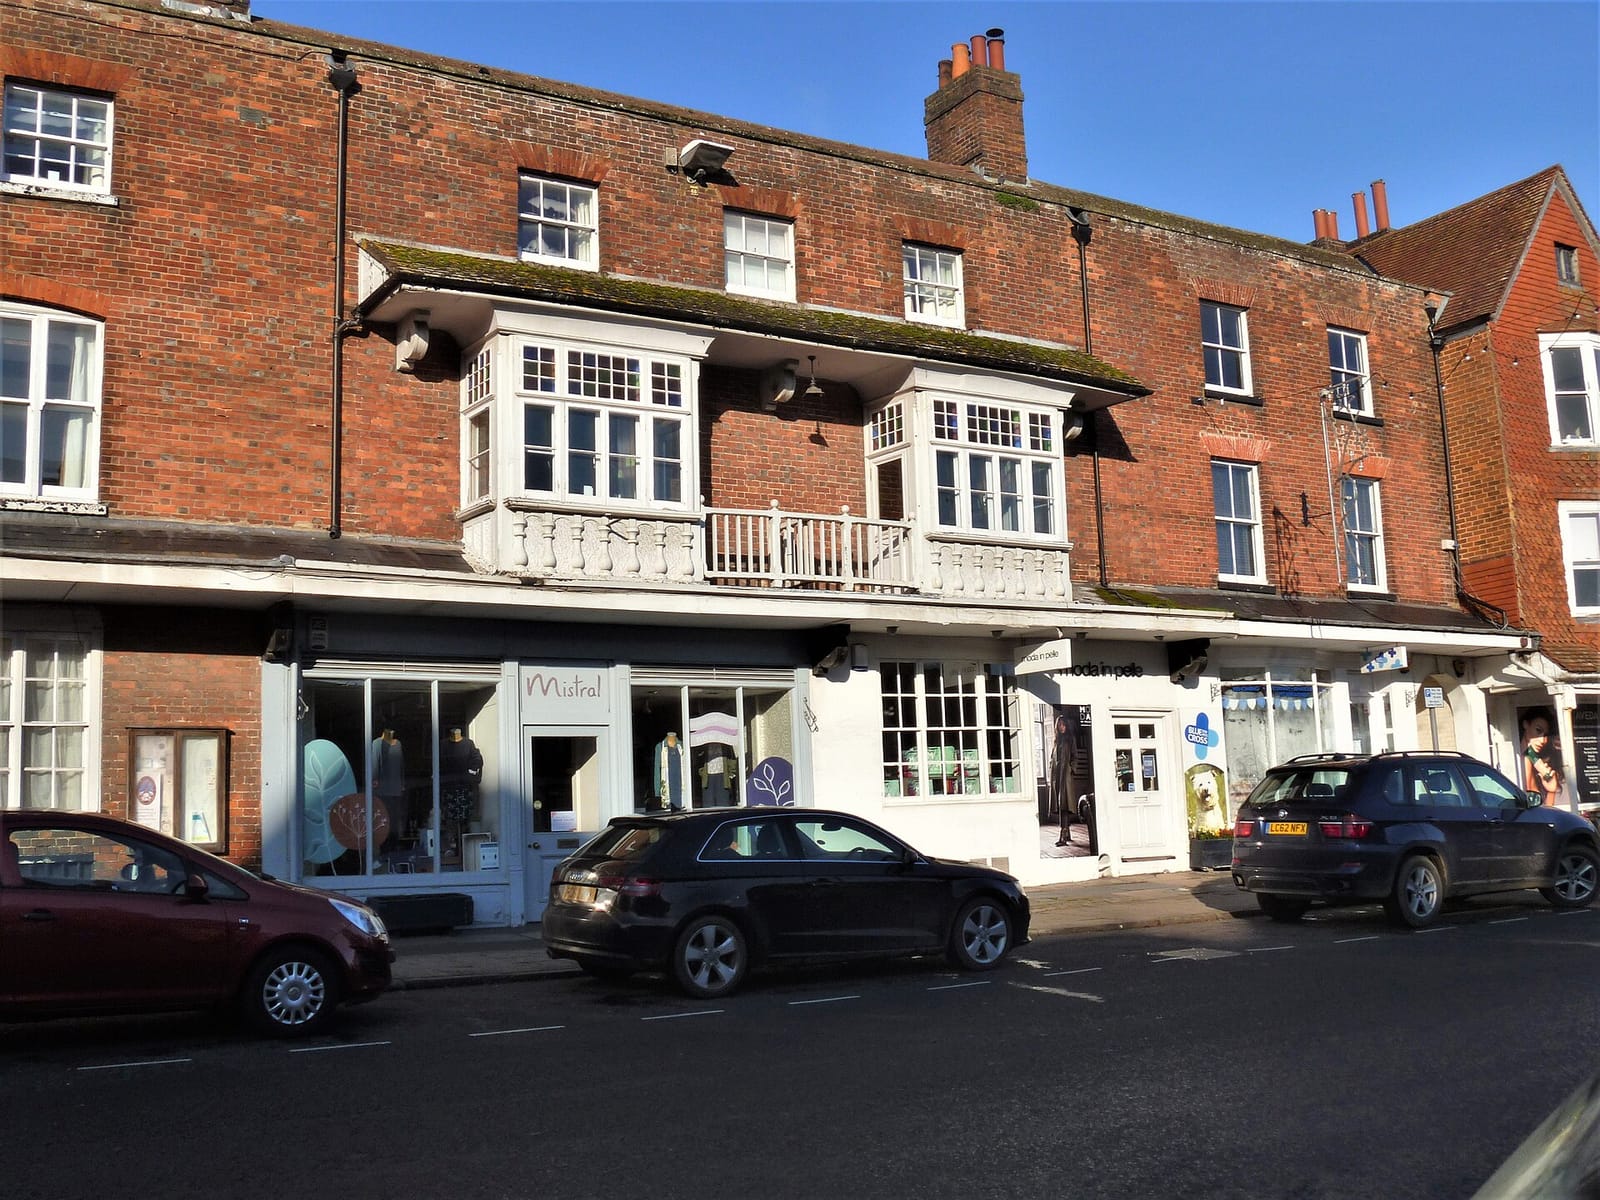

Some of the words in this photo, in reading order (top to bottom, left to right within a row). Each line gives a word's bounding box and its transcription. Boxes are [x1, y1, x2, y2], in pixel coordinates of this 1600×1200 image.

[526, 673, 601, 697] Mistral
[1188, 726, 1202, 735] BLUE
[1188, 734, 1208, 744] CROSS
[1270, 824, 1289, 833] LC62
[1290, 824, 1305, 833] NFX
